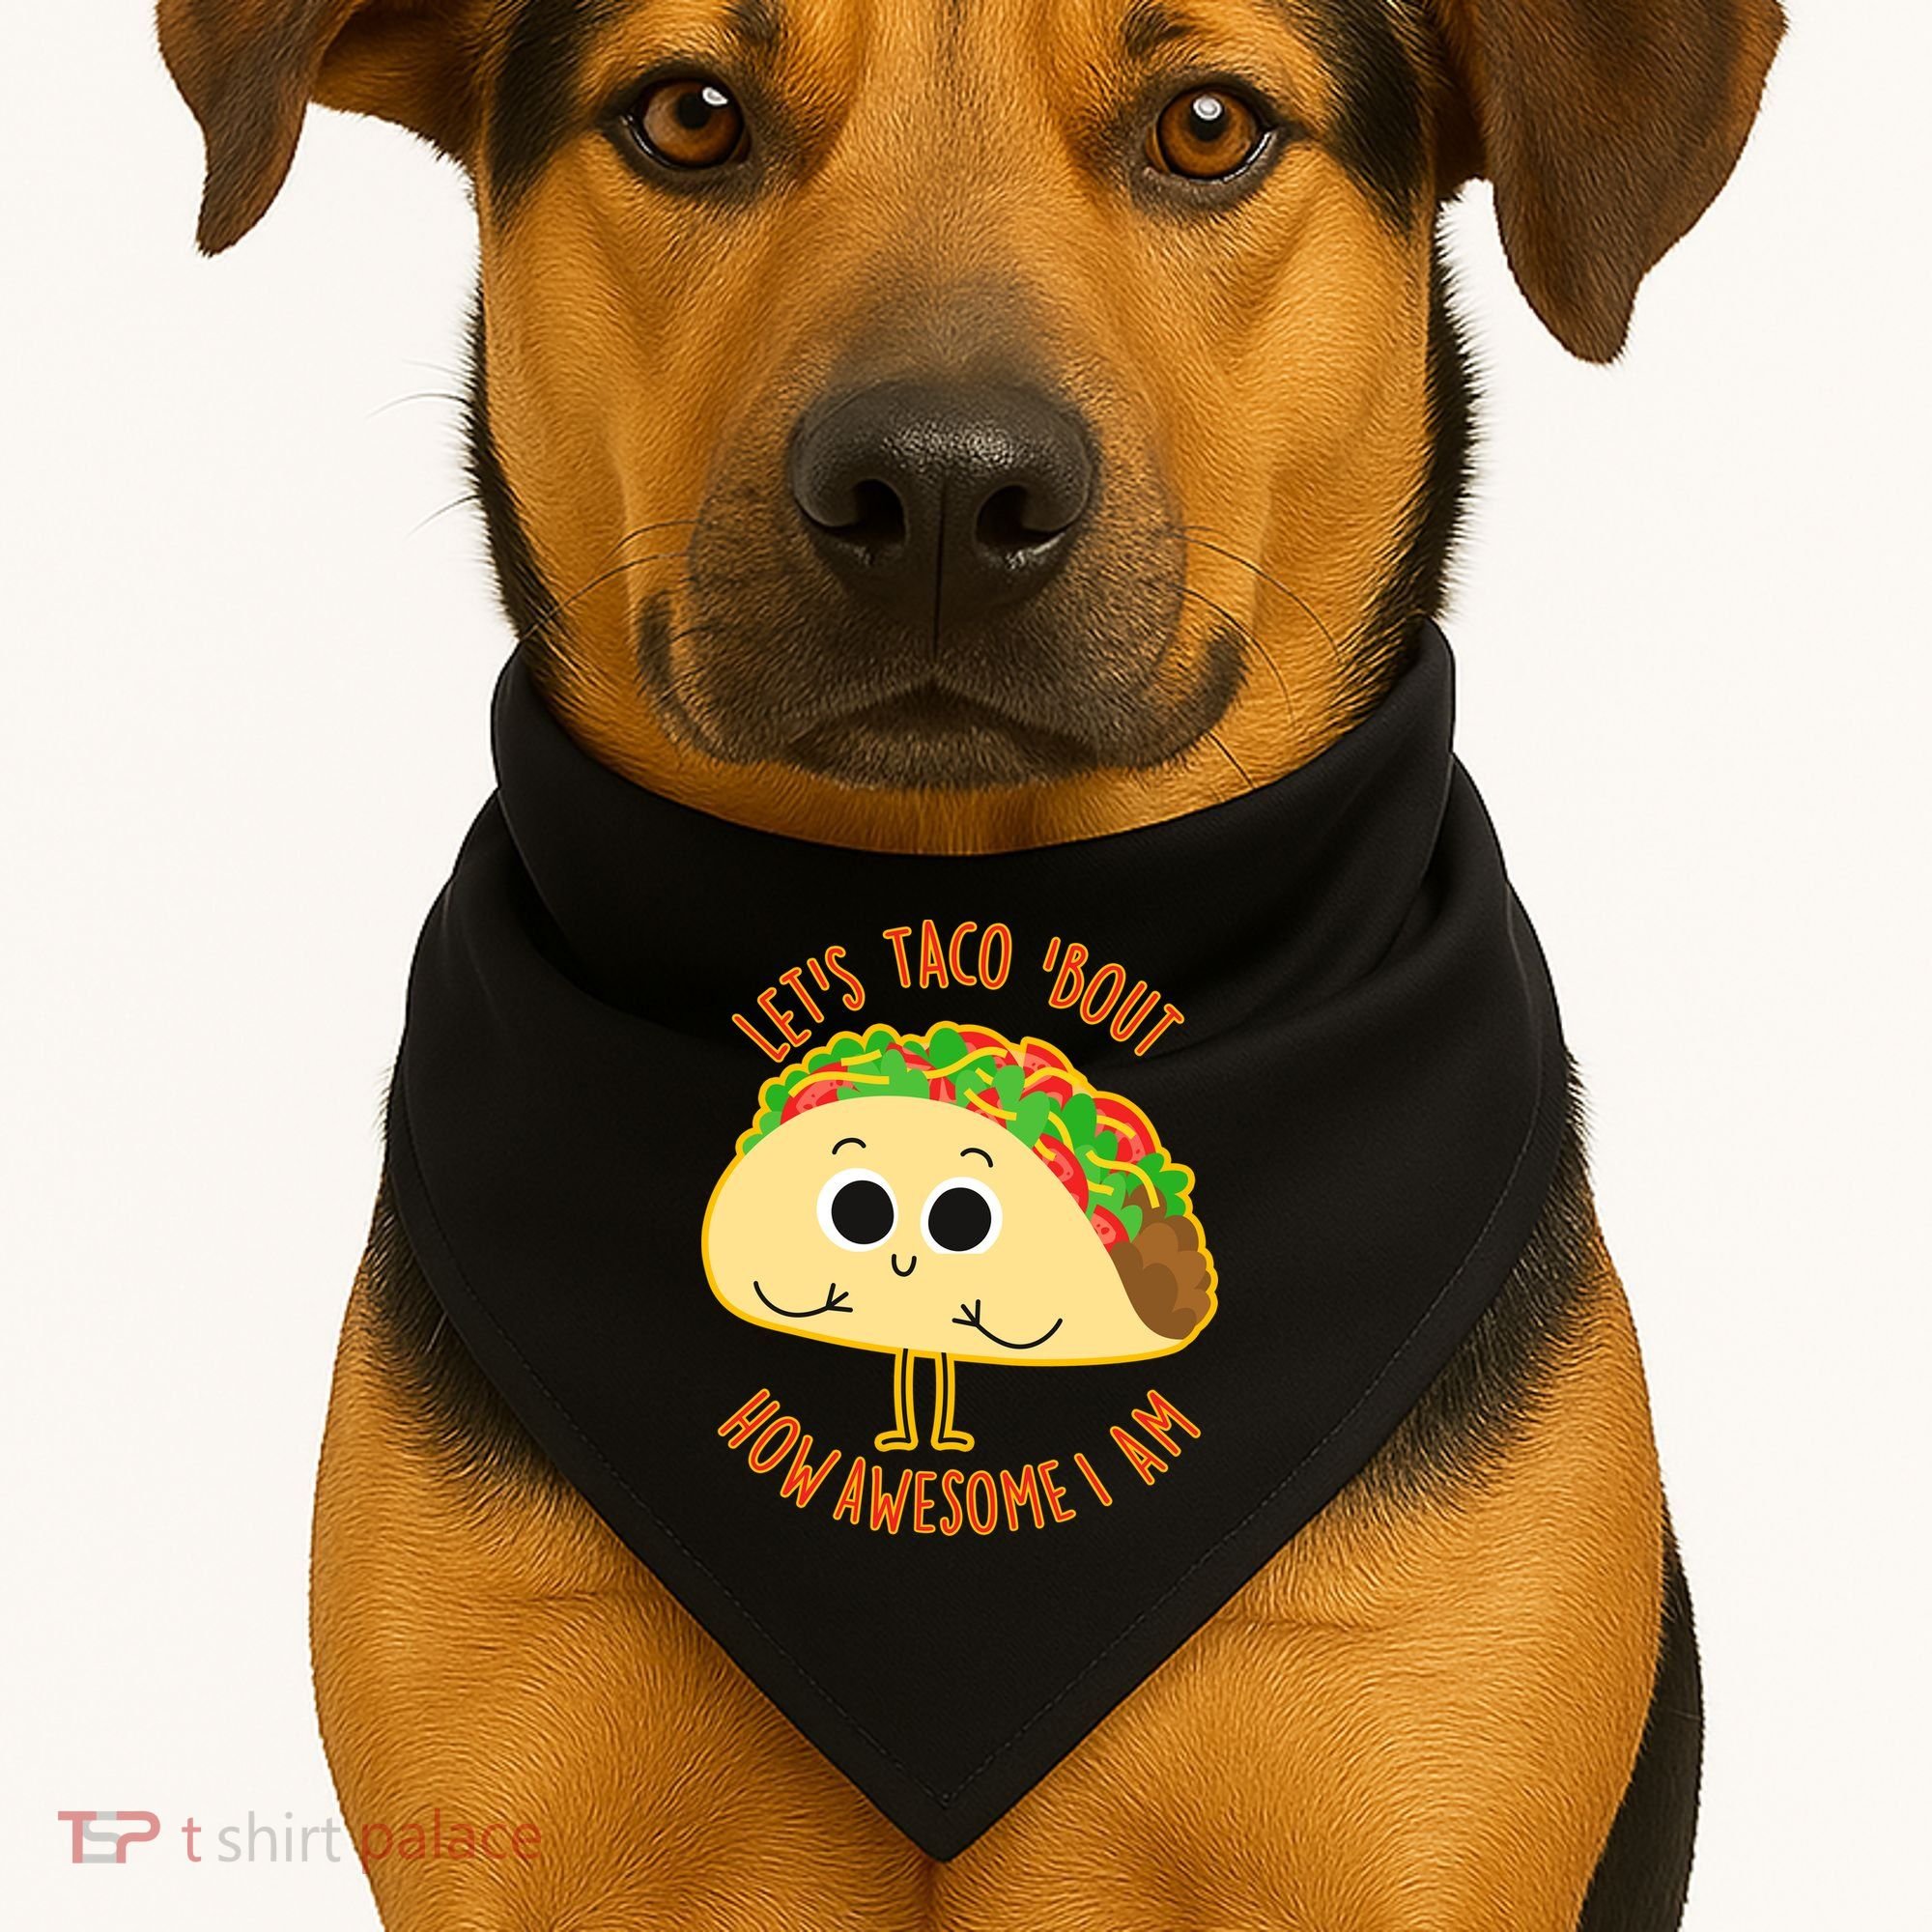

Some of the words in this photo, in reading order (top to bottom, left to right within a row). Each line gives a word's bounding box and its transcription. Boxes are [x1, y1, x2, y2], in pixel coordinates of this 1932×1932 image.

[731, 946, 866, 1064] LET'S
[883, 920, 1012, 990] TACO
[1042, 937, 1184, 1057] 'BOUT
[718, 1388, 841, 1508] HOW
[833, 1456, 1076, 1536] AWESOME
[1074, 1453, 1113, 1506] I
[1110, 1389, 1201, 1486] AM
